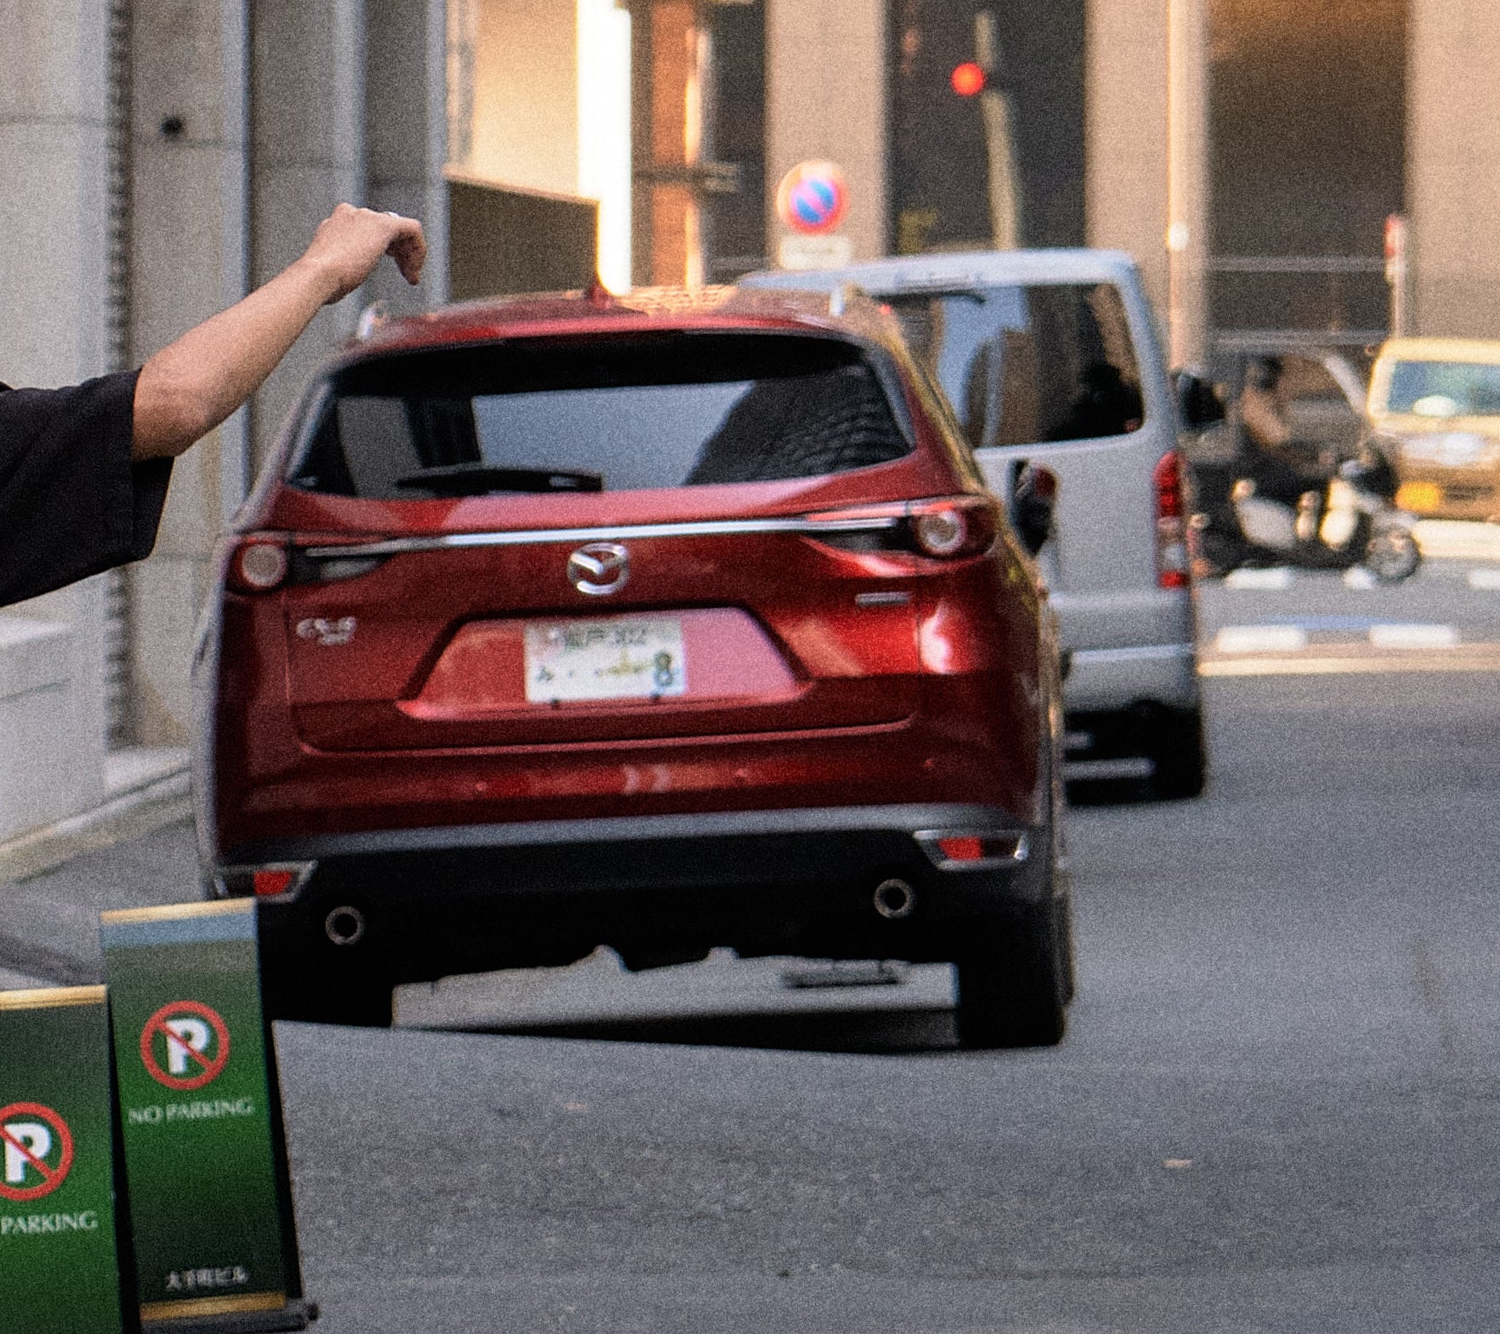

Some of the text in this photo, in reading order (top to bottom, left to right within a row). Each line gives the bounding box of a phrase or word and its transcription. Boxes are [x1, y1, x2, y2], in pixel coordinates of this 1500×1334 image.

[128, 1096, 256, 1125] NO PARKING
[0, 1209, 99, 1235] PARKING
